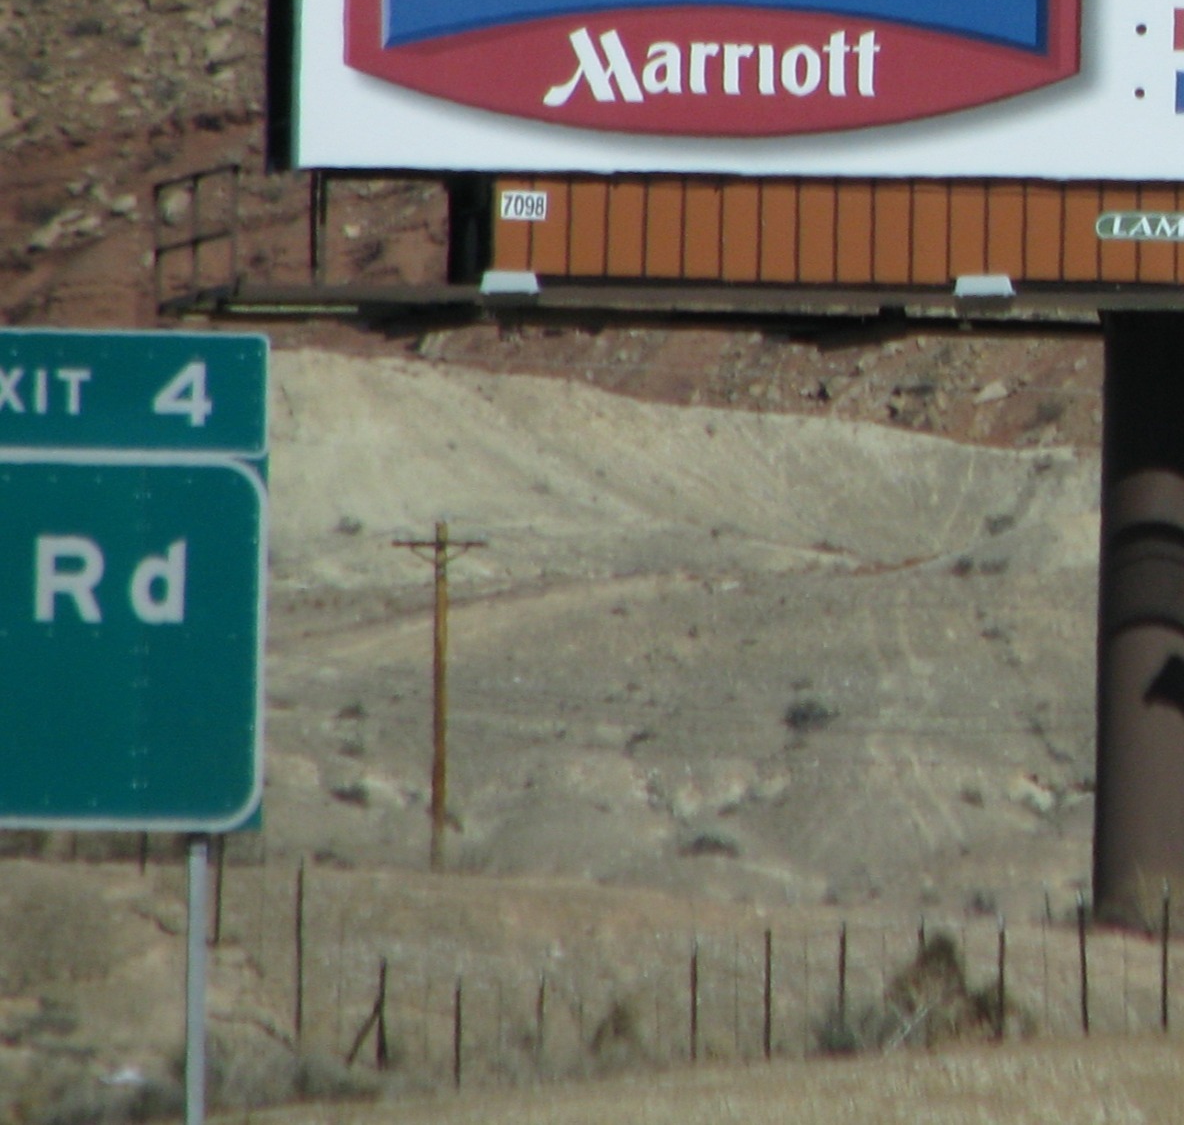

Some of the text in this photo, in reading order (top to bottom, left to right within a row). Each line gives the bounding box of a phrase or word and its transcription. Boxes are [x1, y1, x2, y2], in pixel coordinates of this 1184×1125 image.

[543, 27, 880, 107] Marriott
[503, 194, 545, 217] 7098
[152, 360, 213, 428] 4
[34, 535, 187, 625] Rd
